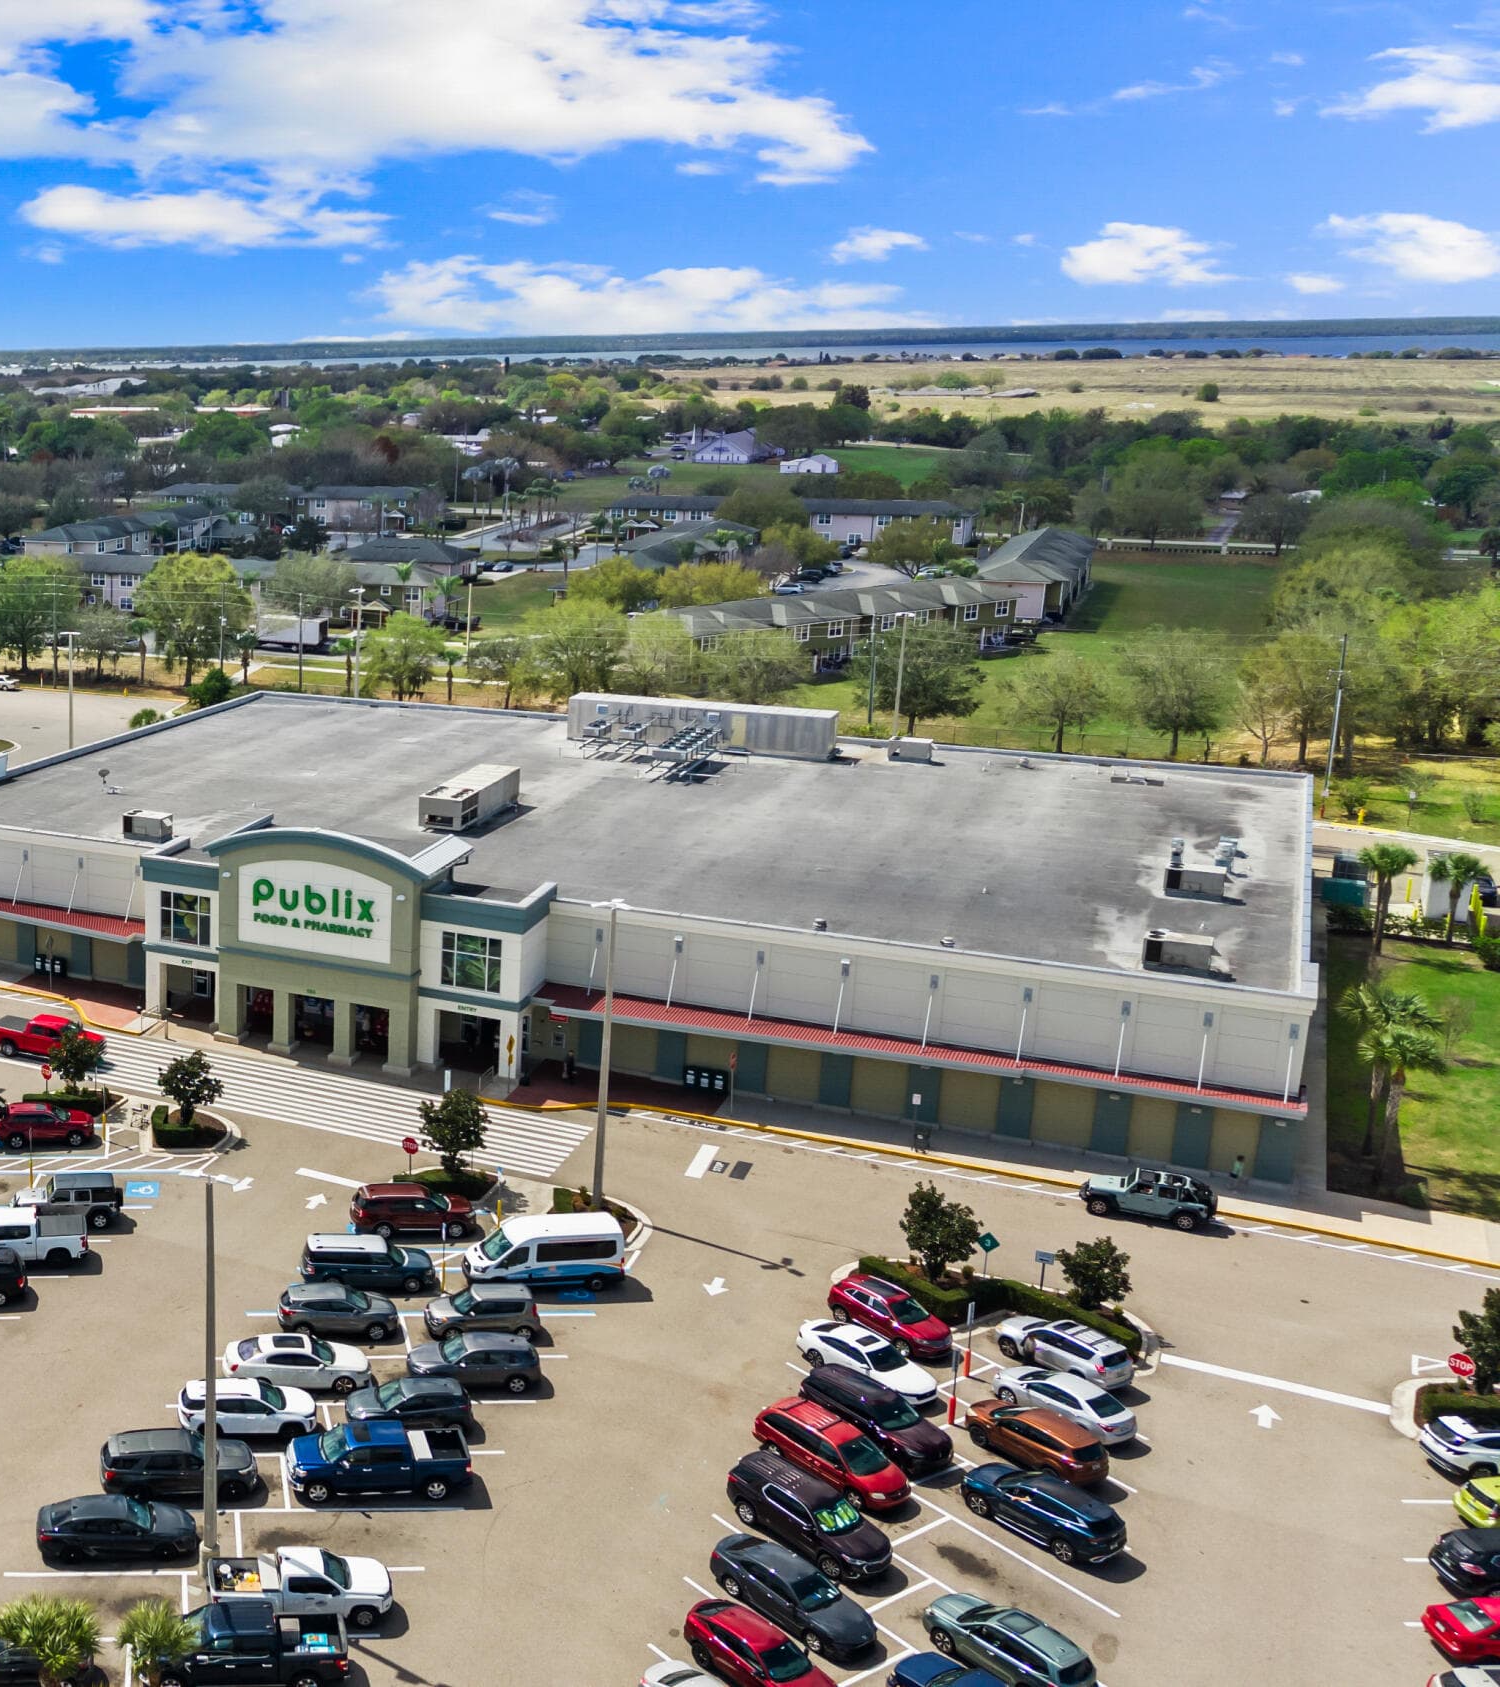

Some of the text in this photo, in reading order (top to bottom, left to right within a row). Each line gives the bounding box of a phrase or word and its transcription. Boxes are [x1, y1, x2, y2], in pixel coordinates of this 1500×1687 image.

[253, 879, 374, 922] Publix
[253, 912, 372, 938] FOOD & PHARMACY
[404, 1141, 417, 1150] STOP
[985, 1239, 991, 1247] 3
[1448, 1358, 1473, 1372] STOP
